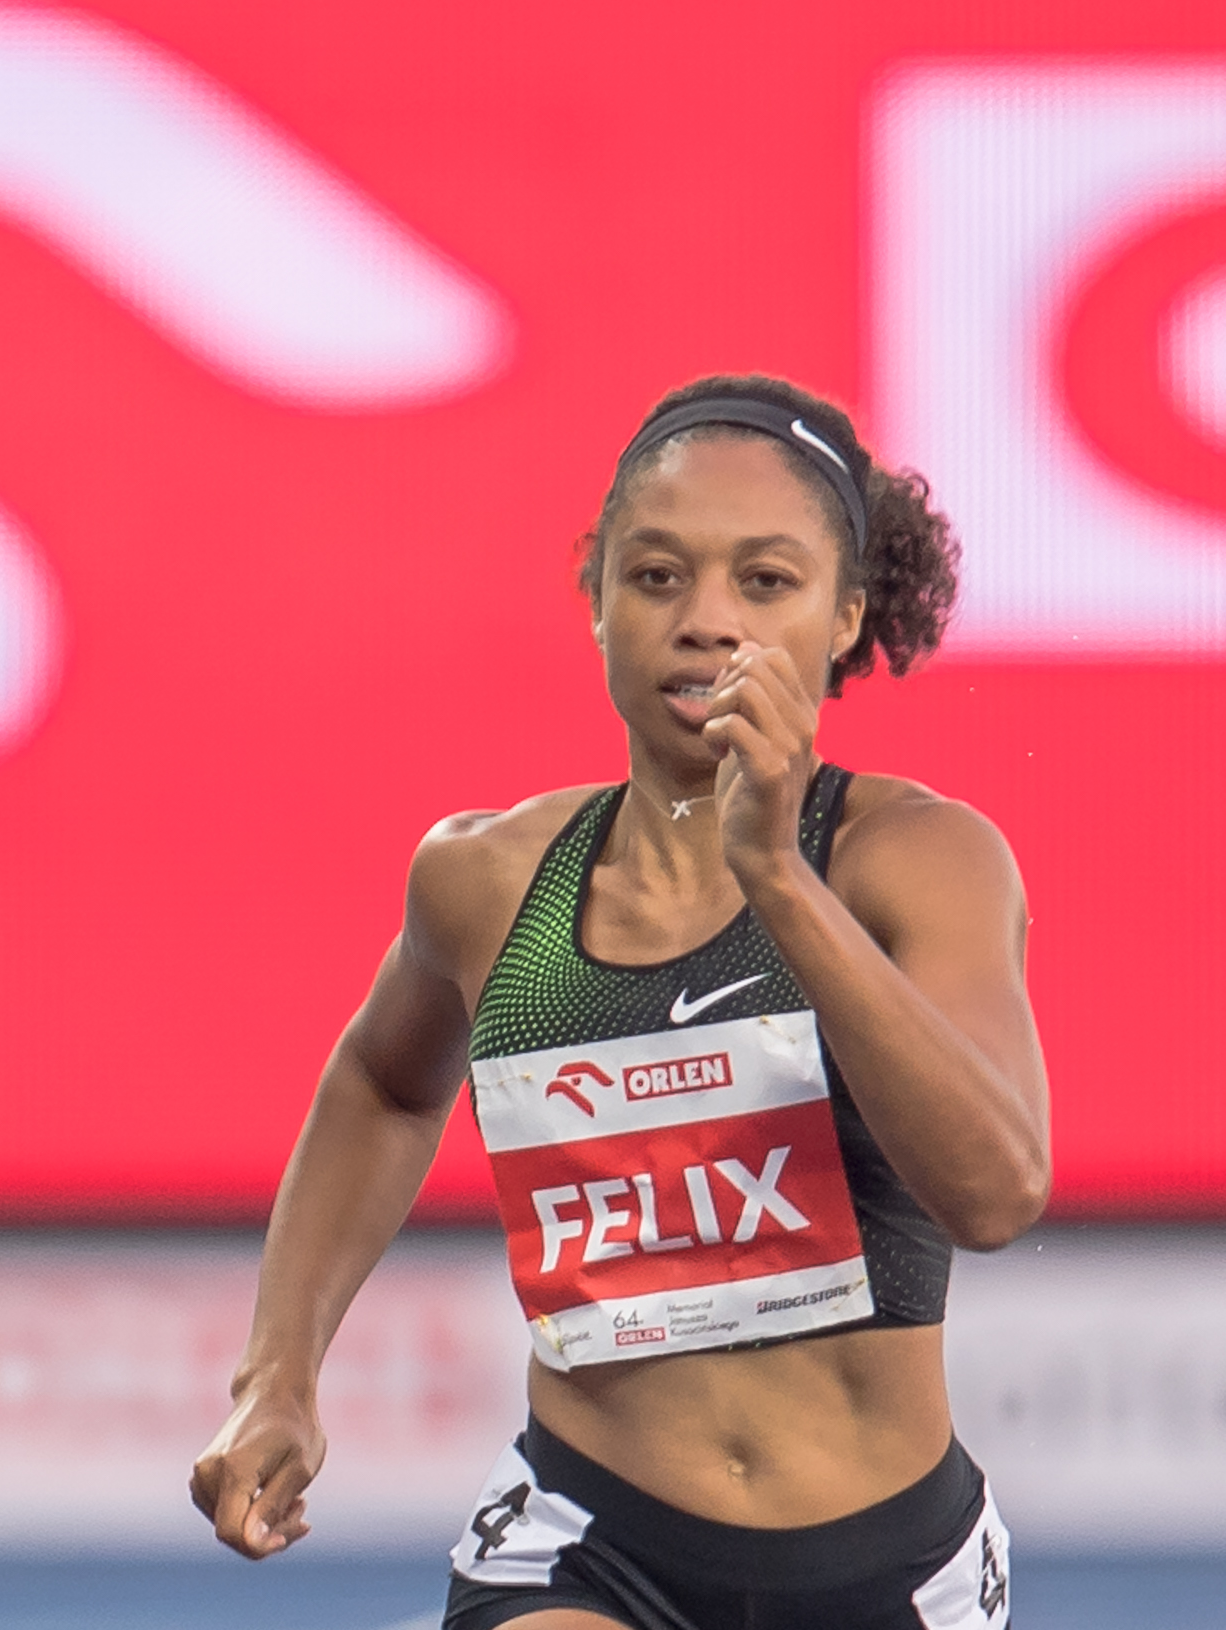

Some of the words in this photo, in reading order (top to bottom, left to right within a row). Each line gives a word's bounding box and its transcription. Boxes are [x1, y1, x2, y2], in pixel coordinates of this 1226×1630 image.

[629, 1056, 726, 1095] ORLEN
[531, 1145, 811, 1273] FELIX
[756, 1284, 851, 1315] BRIDGESTONE
[616, 1329, 664, 1345] ORLEN
[471, 1481, 531, 1560] 4
